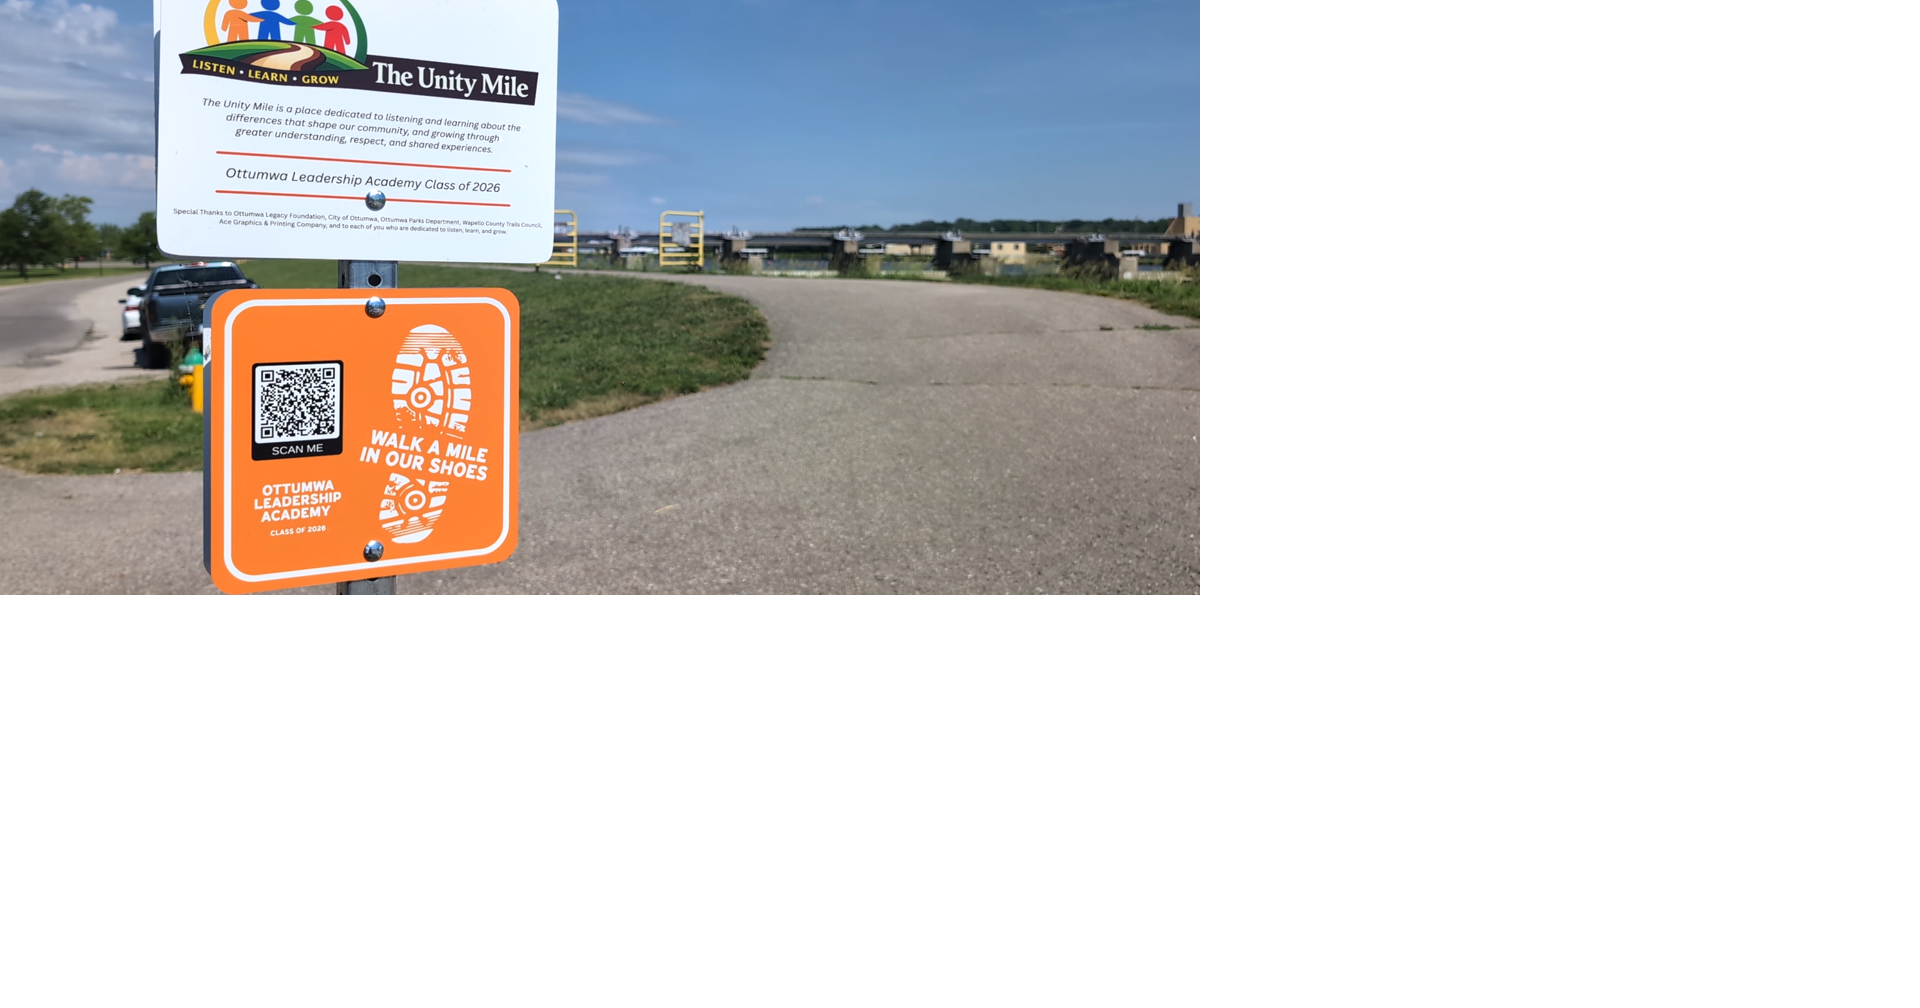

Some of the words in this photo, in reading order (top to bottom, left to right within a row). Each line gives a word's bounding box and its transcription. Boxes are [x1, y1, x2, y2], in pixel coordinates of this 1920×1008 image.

[193, 60, 235, 75] LISTEN
[248, 70, 288, 82] LEARN
[302, 75, 339, 84] GROW
[372, 62, 413, 86] The
[417, 66, 477, 97] Unity
[481, 73, 528, 98] Mile
[203, 98, 220, 107] The
[224, 100, 250, 110] Unity
[253, 102, 273, 111] Mile
[276, 104, 283, 112] is
[295, 106, 322, 115] place
[324, 109, 372, 119] dedicated
[386, 113, 423, 125] listening
[425, 116, 442, 126] and
[444, 118, 479, 130] learning
[481, 122, 505, 131] about
[507, 124, 521, 132] the
[226, 114, 282, 125] differences
[285, 117, 305, 127] that
[308, 120, 337, 130] shape
[339, 123, 355, 131] our
[357, 124, 409, 136] community,
[412, 128, 429, 136] and
[431, 130, 465, 141] growing
[467, 132, 499, 143] through
[235, 128, 272, 137] greater
[275, 130, 347, 144] understanding,
[350, 136, 386, 146] respect,
[389, 138, 406, 148] and
[409, 140, 439, 150] shared
[441, 144, 493, 153] experiences.
[226, 167, 288, 181] Ottumwa
[292, 171, 362, 186] Leadership
[365, 176, 422, 190] Academy
[424, 179, 455, 190] Class
[458, 181, 471, 191] of
[473, 182, 500, 193] 2026
[233, 219, 262, 227] Graphics
[270, 220, 295, 228] Printing
[272, 445, 303, 455] SCAN
[307, 444, 323, 452] ME
[371, 429, 424, 452] WALK
[427, 440, 439, 455] A
[446, 443, 488, 463] MILE
[360, 447, 380, 463] IN
[385, 451, 424, 471] OUR
[428, 458, 488, 481] SHOES
[262, 480, 334, 496] OTTUMWA
[254, 492, 342, 510] LEADERSHIP
[261, 505, 331, 522] ACADEMY
[270, 528, 294, 536] CLASS
